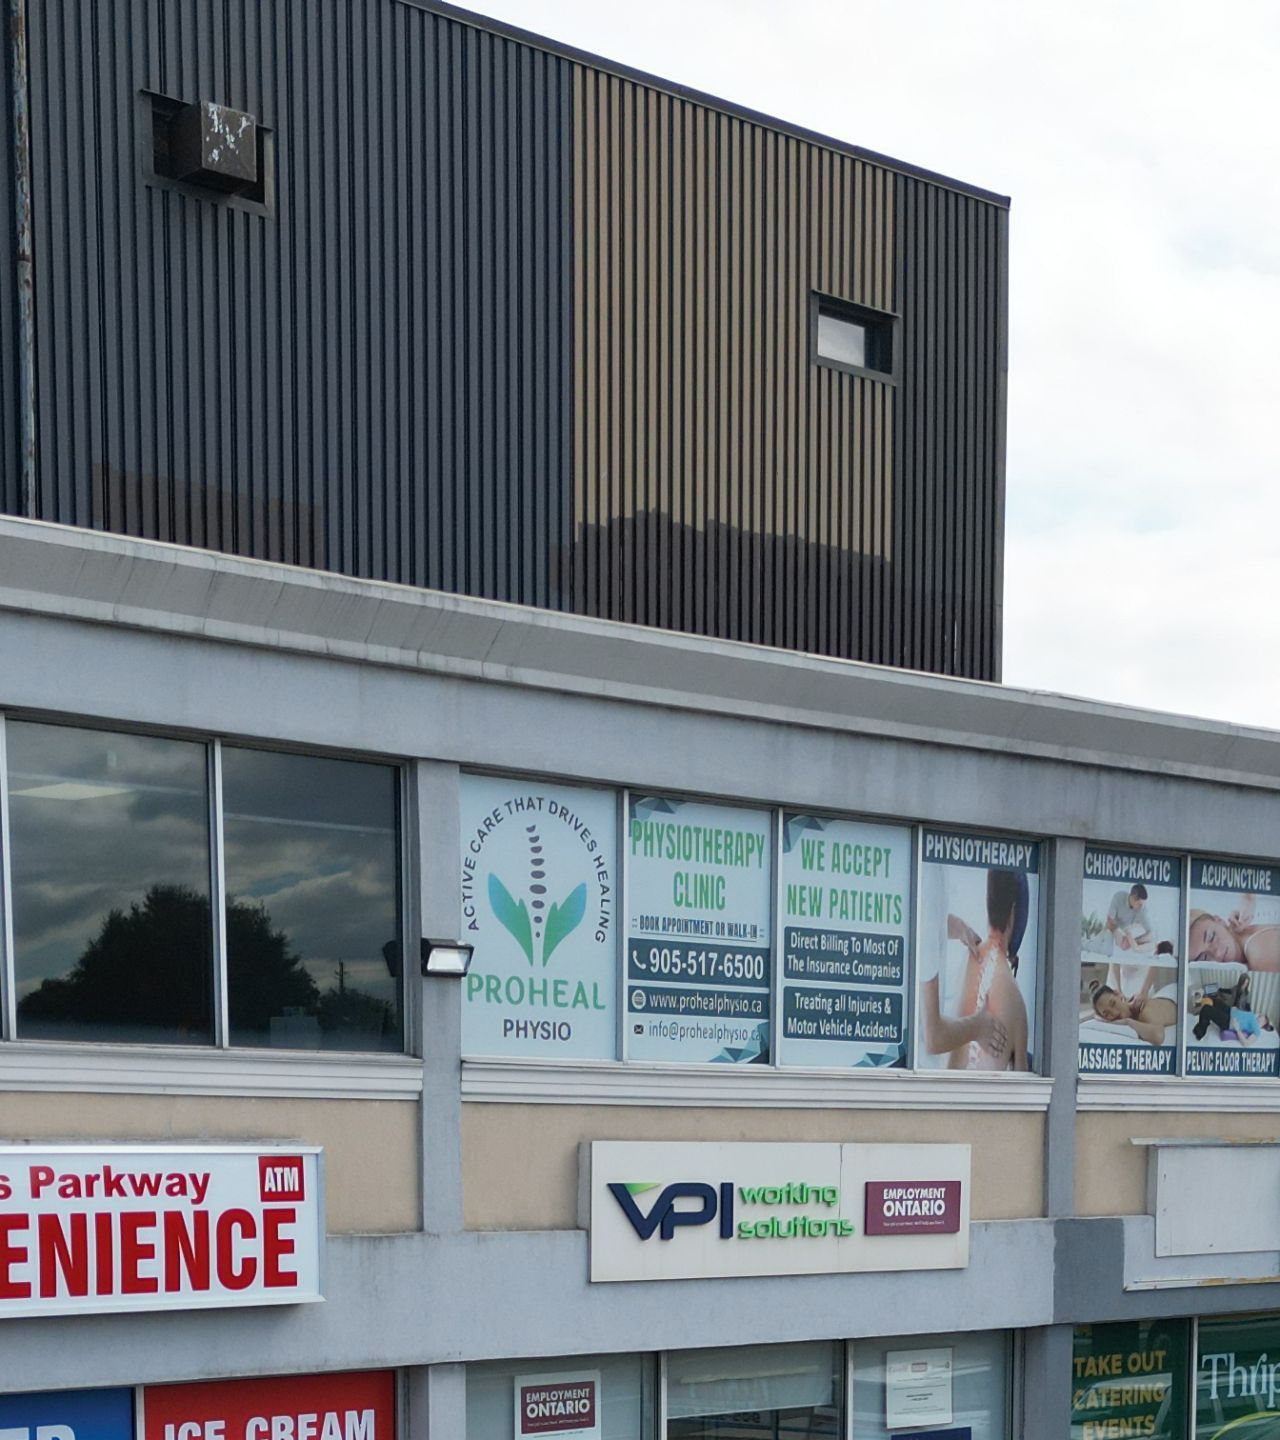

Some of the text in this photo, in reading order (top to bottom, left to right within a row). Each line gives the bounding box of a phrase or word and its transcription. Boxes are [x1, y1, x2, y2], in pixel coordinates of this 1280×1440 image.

[632, 819, 765, 869] PHYSIOTHERAPY
[926, 834, 1033, 868] PHYSIOTHERAPY
[462, 797, 611, 943] ACTIVE CARE THAT DRIVES HEALING
[801, 838, 892, 878] WE ACCEPT
[1085, 852, 1170, 882] CHIROPRACTIC
[674, 871, 725, 910] CLINIC
[1201, 864, 1272, 891] ACUPUNCTURE
[787, 884, 902, 925] NEW PATIENTS
[640, 915, 758, 938] BOOK APPOINTMENT OR WALK-IN
[790, 931, 899, 956] Direct Billing To Most Of
[649, 947, 764, 980] 905-517-6500
[787, 955, 901, 980] The Insurance Companies
[467, 972, 606, 1011] PROHEAL
[650, 991, 762, 1014] www.prohealphysio.ca
[794, 992, 891, 1016] Treating all Injuries &
[503, 1019, 571, 1041] PHYSIO
[649, 1019, 761, 1043] info@prohealphysio.ca
[787, 1017, 898, 1038] Motor Vehicle Accidents
[1126, 1049, 1171, 1072] THERAPY
[1187, 1051, 1276, 1073] PELVIC FLOOR THERAPY
[29, 1165, 211, 1205] Parkway
[264, 1163, 300, 1194] ATM
[739, 1182, 839, 1208] working
[883, 1187, 946, 1200] EMPLOYMENT
[606, 1182, 734, 1241] VPI
[883, 1200, 946, 1217] ONTARIO
[737, 1216, 855, 1239] solutions
[1074, 1350, 1166, 1377] TAKE OUT
[526, 1388, 590, 1403] EMPLOYMENT
[1073, 1382, 1166, 1410] CATERING
[526, 1399, 590, 1419] ONTARIO
